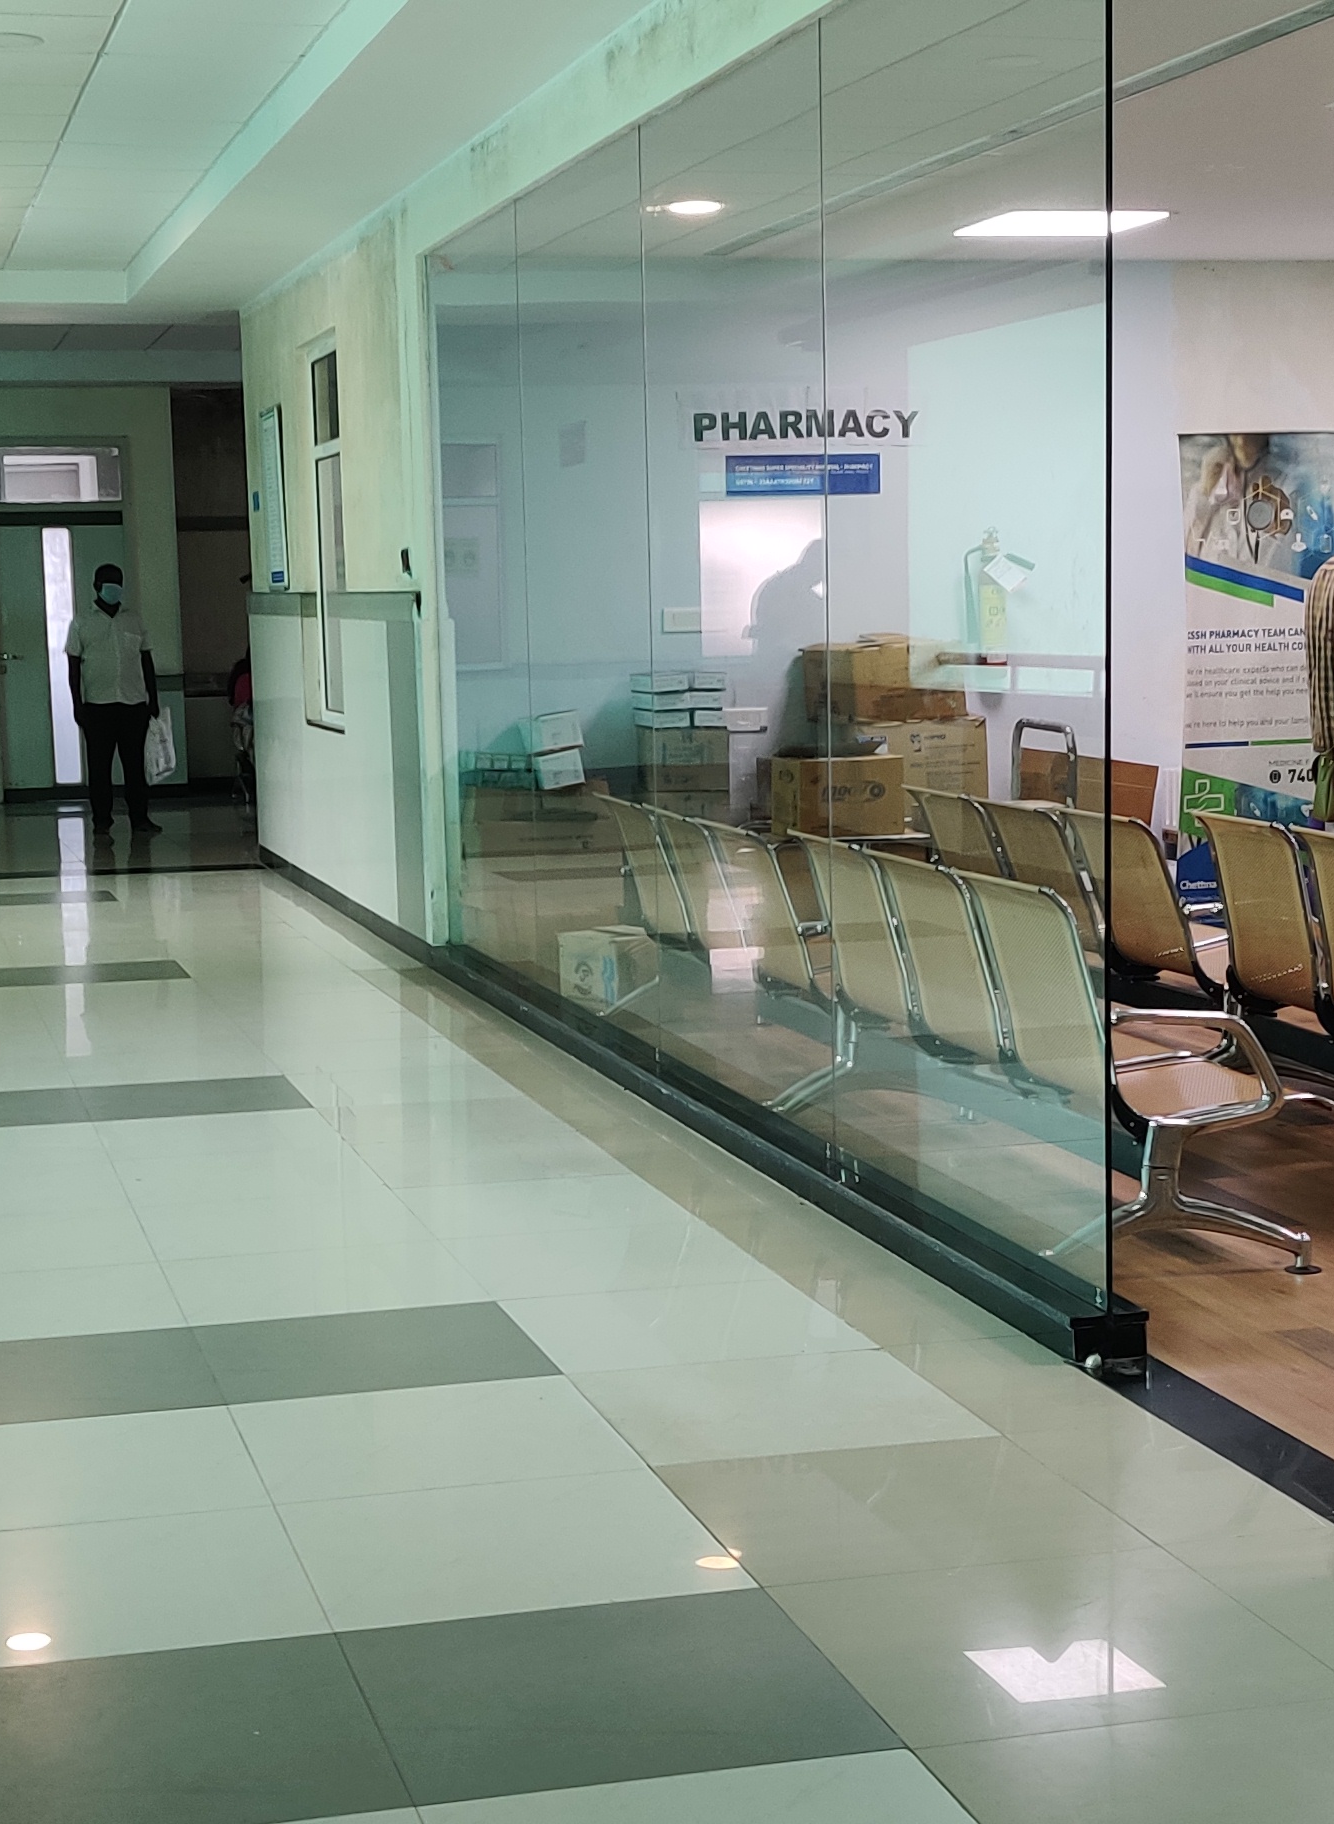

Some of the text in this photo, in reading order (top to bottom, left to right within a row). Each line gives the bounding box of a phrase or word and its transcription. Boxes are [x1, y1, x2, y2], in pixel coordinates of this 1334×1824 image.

[693, 409, 920, 442] PHARMACY
[1209, 629, 1259, 639] PHARMACY
[1261, 628, 1286, 638] TEAM
[1208, 644, 1224, 653] ALL
[1226, 643, 1252, 653] YOUR
[1254, 642, 1289, 652] HEALTH
